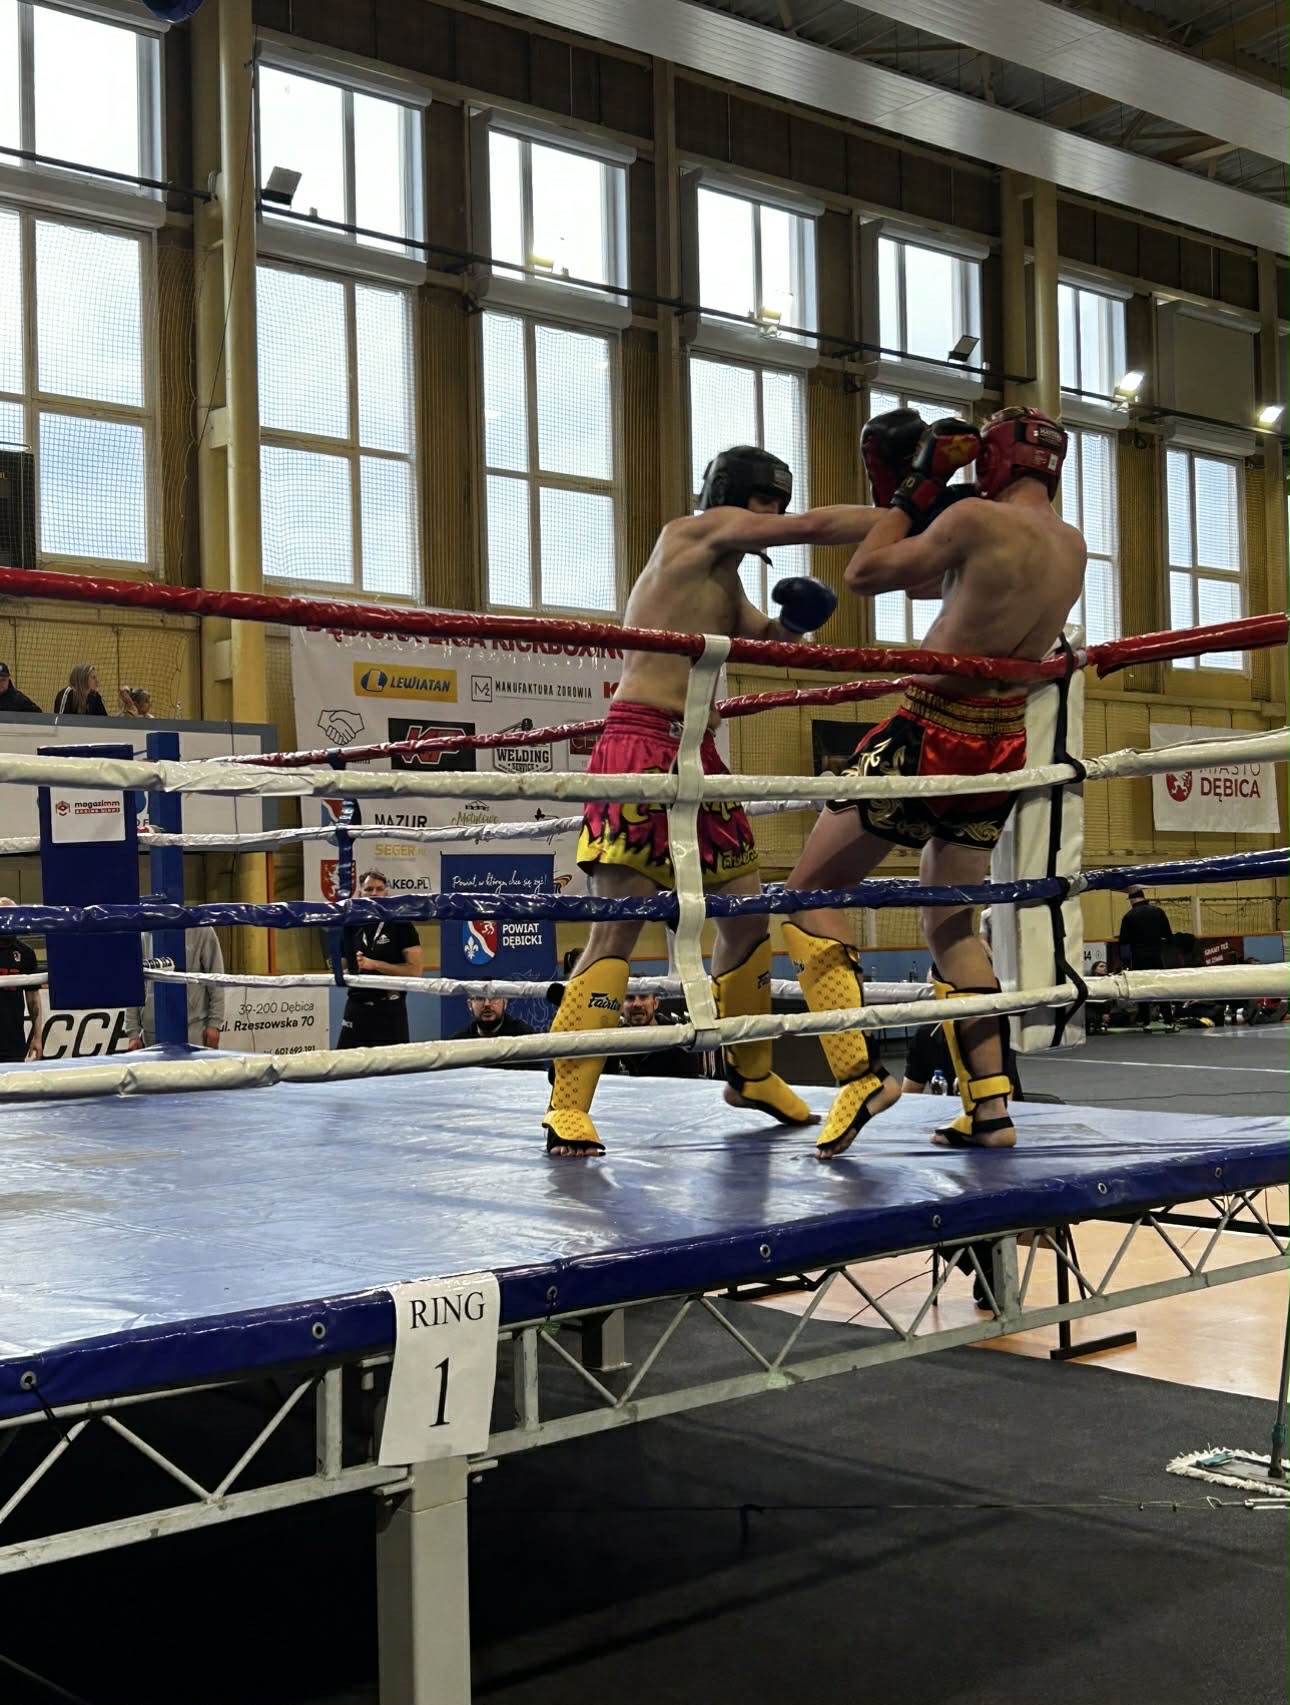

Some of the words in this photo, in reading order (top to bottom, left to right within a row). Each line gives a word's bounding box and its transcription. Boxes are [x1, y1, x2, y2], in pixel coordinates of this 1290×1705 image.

[390, 675, 451, 693] LEWIATAN
[495, 680, 553, 697] MANUFAKTURA
[557, 684, 592, 699] ZDROWIA
[496, 748, 550, 764] WELDING
[511, 762, 535, 773] SERVICE
[1200, 777, 1261, 802] DĘBICA
[374, 813, 428, 828] MAZUR
[375, 843, 417, 857] SEGER
[502, 922, 540, 934] POWIAT
[502, 934, 543, 949] DĘBICKI
[238, 1002, 278, 1016] 39-200
[280, 1000, 315, 1014] Dębica
[234, 1016, 298, 1032] Rzeszowska
[301, 1015, 315, 1027] 70
[409, 1291, 487, 1330] RING
[428, 1356, 451, 1428] 1
